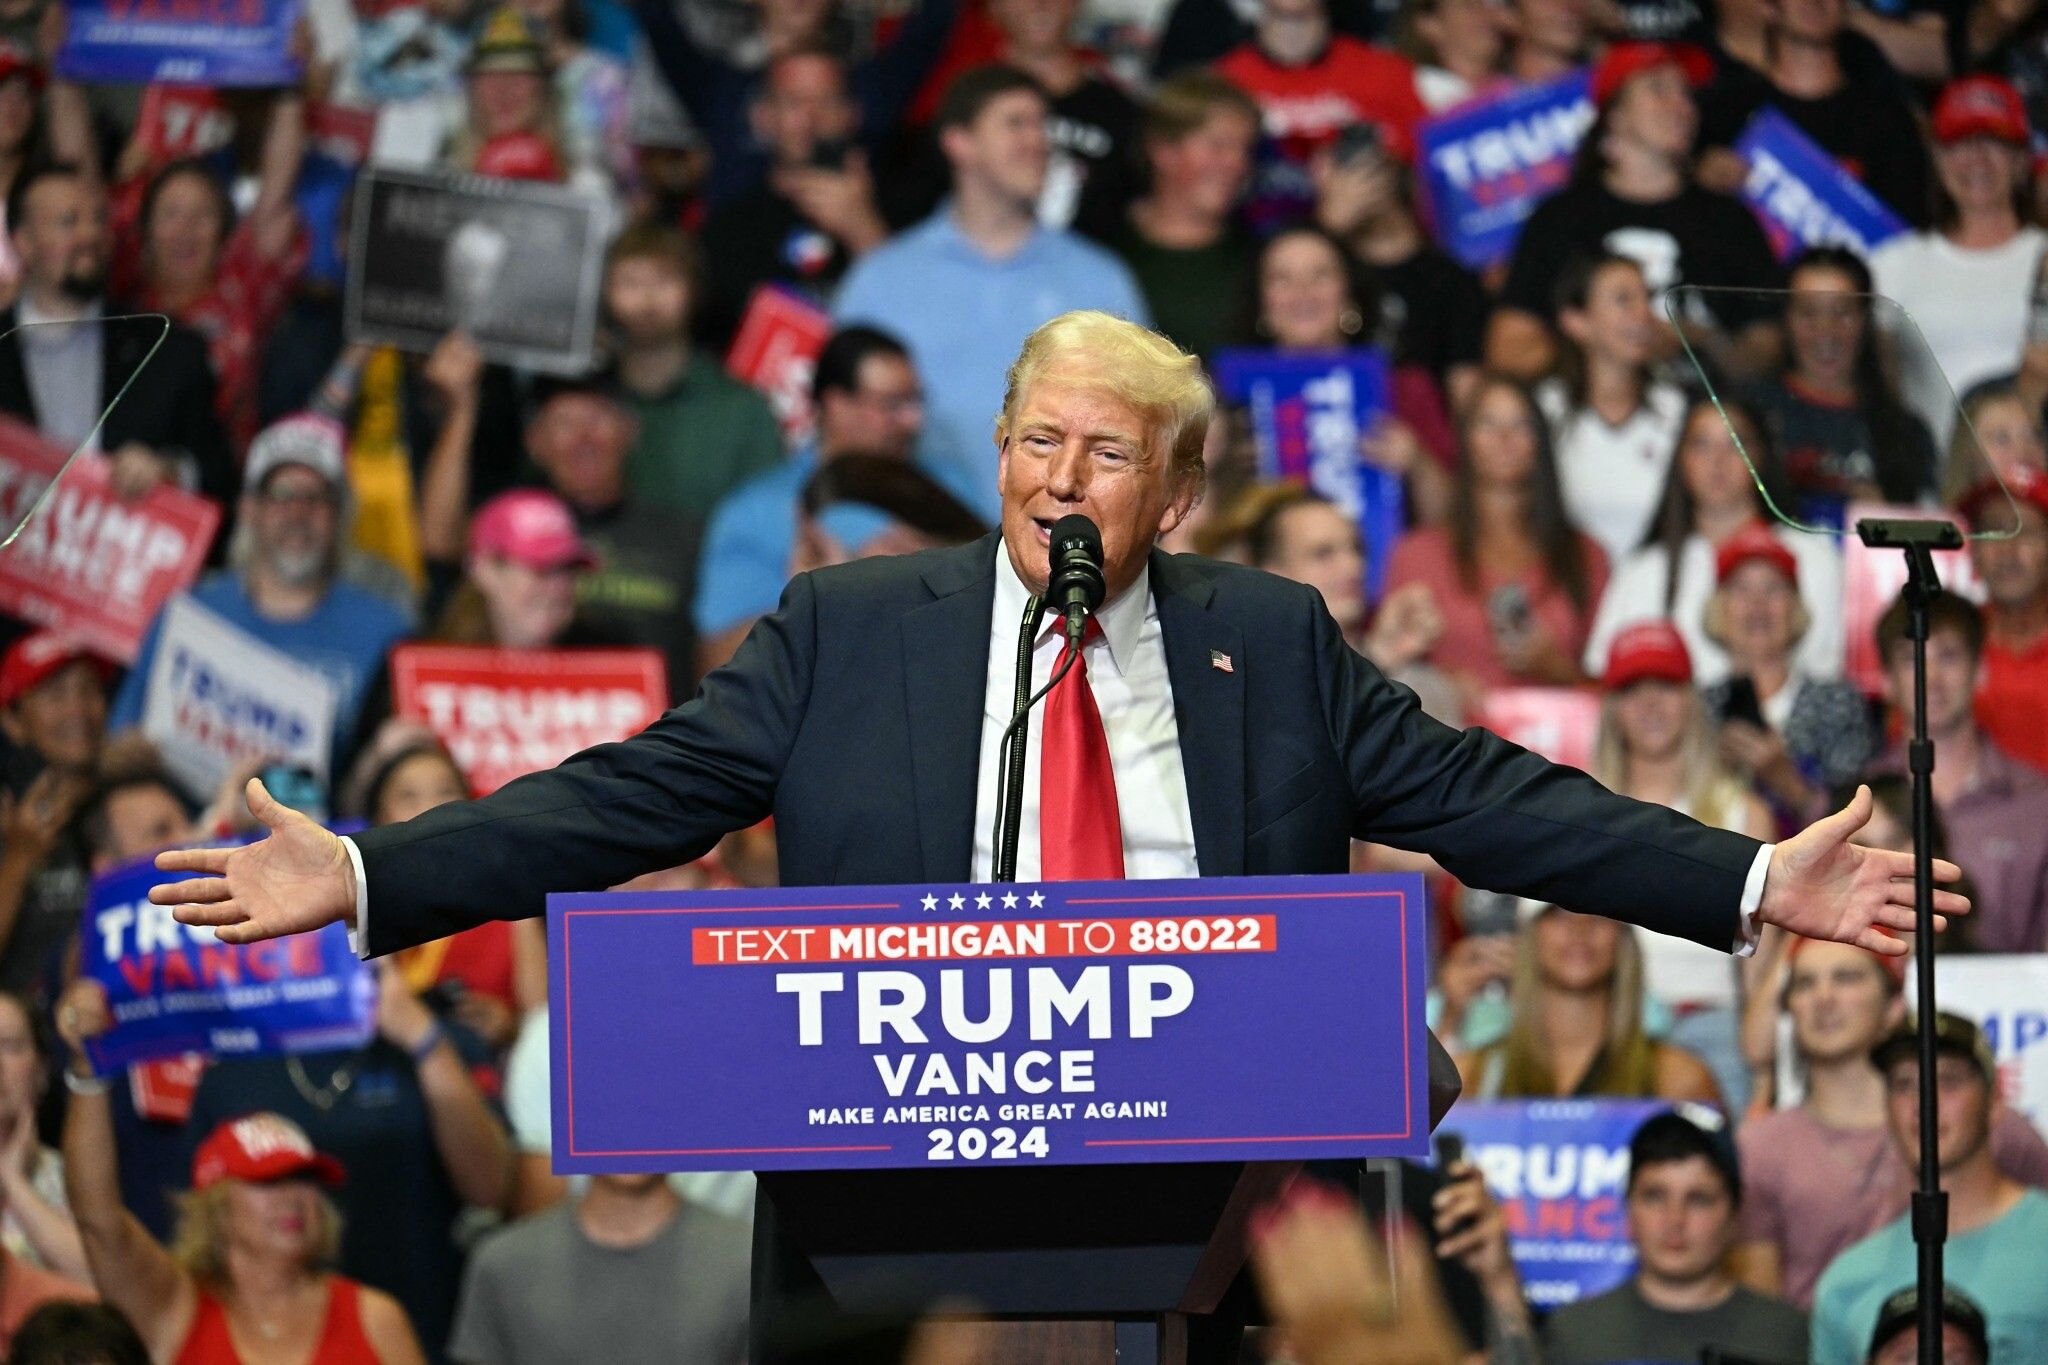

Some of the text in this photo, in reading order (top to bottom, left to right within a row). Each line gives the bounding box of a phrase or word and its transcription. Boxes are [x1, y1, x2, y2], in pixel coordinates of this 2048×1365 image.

[1431, 97, 1598, 192] TRUM
[418, 681, 647, 738] TRUMP
[118, 936, 325, 998] VANCE
[708, 917, 1262, 962] TEXT MICHIGAN TO 88022
[775, 963, 1195, 1046] TRUMP
[873, 1050, 1096, 1097] VANCE
[808, 1101, 1168, 1125] MAKE AMERICA GREAT AGAIN!
[927, 1125, 1050, 1161] 2024
[1468, 1141, 1634, 1201] RUM
